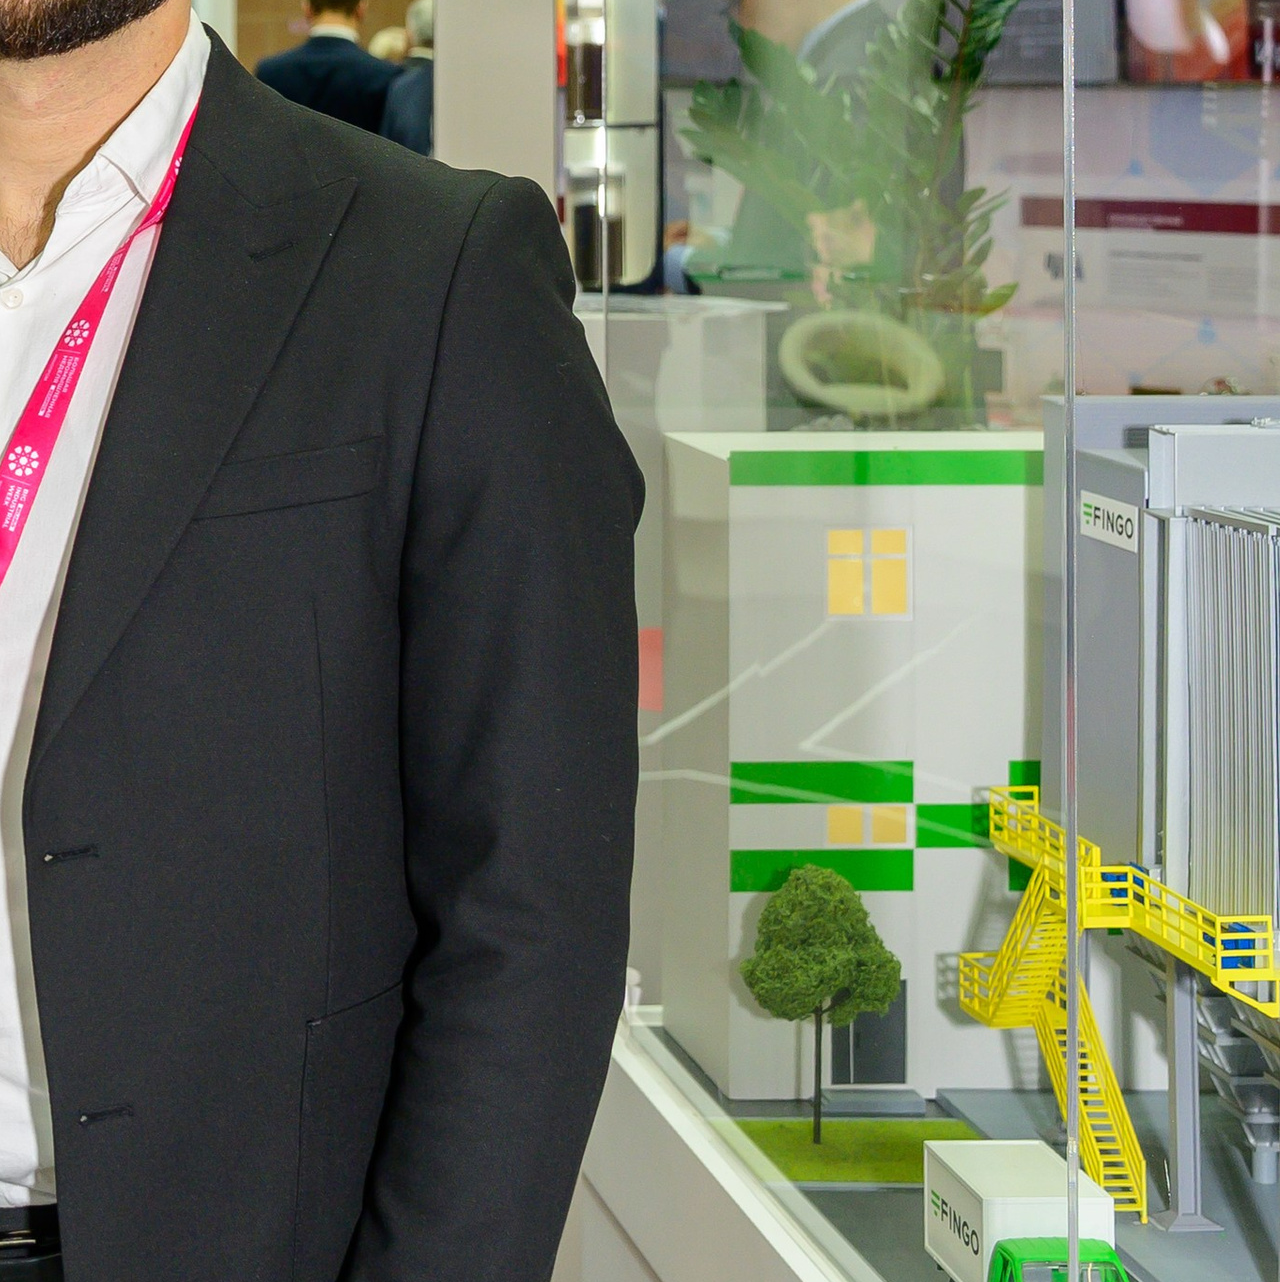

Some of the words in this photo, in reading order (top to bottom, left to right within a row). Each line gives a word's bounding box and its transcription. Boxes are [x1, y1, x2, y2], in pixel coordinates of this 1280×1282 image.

[2, 486, 22, 528] INDUSTRIAL
[3, 485, 15, 506] WEEK
[20, 488, 29, 502] BIG
[1092, 504, 1134, 541] FINGO
[940, 1200, 980, 1256] FINGO
